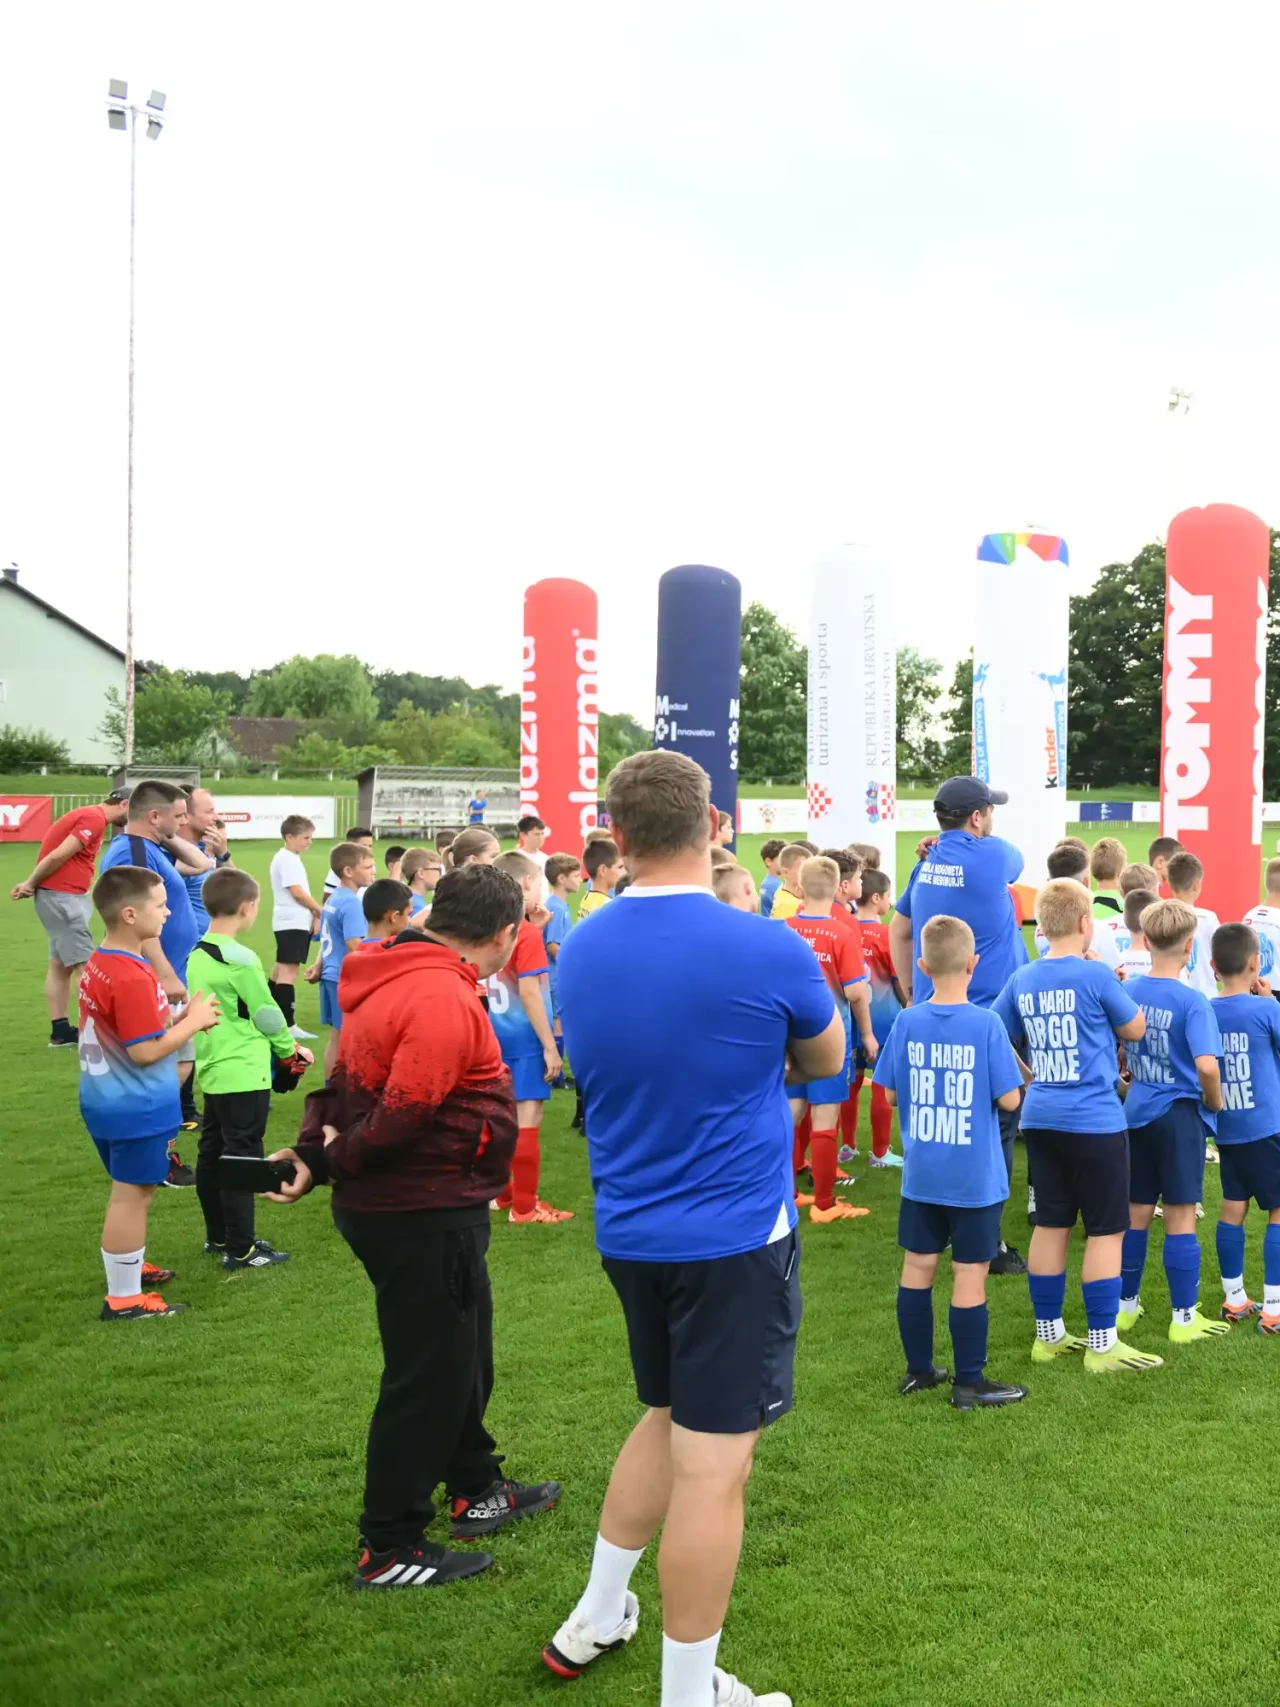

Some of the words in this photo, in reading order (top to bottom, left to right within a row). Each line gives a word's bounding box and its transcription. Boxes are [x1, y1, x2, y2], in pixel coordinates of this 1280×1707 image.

[817, 622, 831, 681] sporta
[817, 695, 829, 767] turizma
[1044, 727, 1057, 789] kinder
[1018, 993, 1034, 1017] GO
[1039, 989, 1076, 1015] HARD
[1048, 1014, 1078, 1048] GO
[1145, 1028, 1169, 1059] GO
[1221, 1032, 1249, 1053] ARD
[908, 1041, 924, 1067] GO
[930, 1041, 975, 1070] HARD
[1224, 1052, 1251, 1082] GO
[910, 1069, 935, 1105] OR
[944, 1071, 974, 1108] GO
[1221, 1081, 1255, 1111] ME
[909, 1106, 972, 1146] HOME
